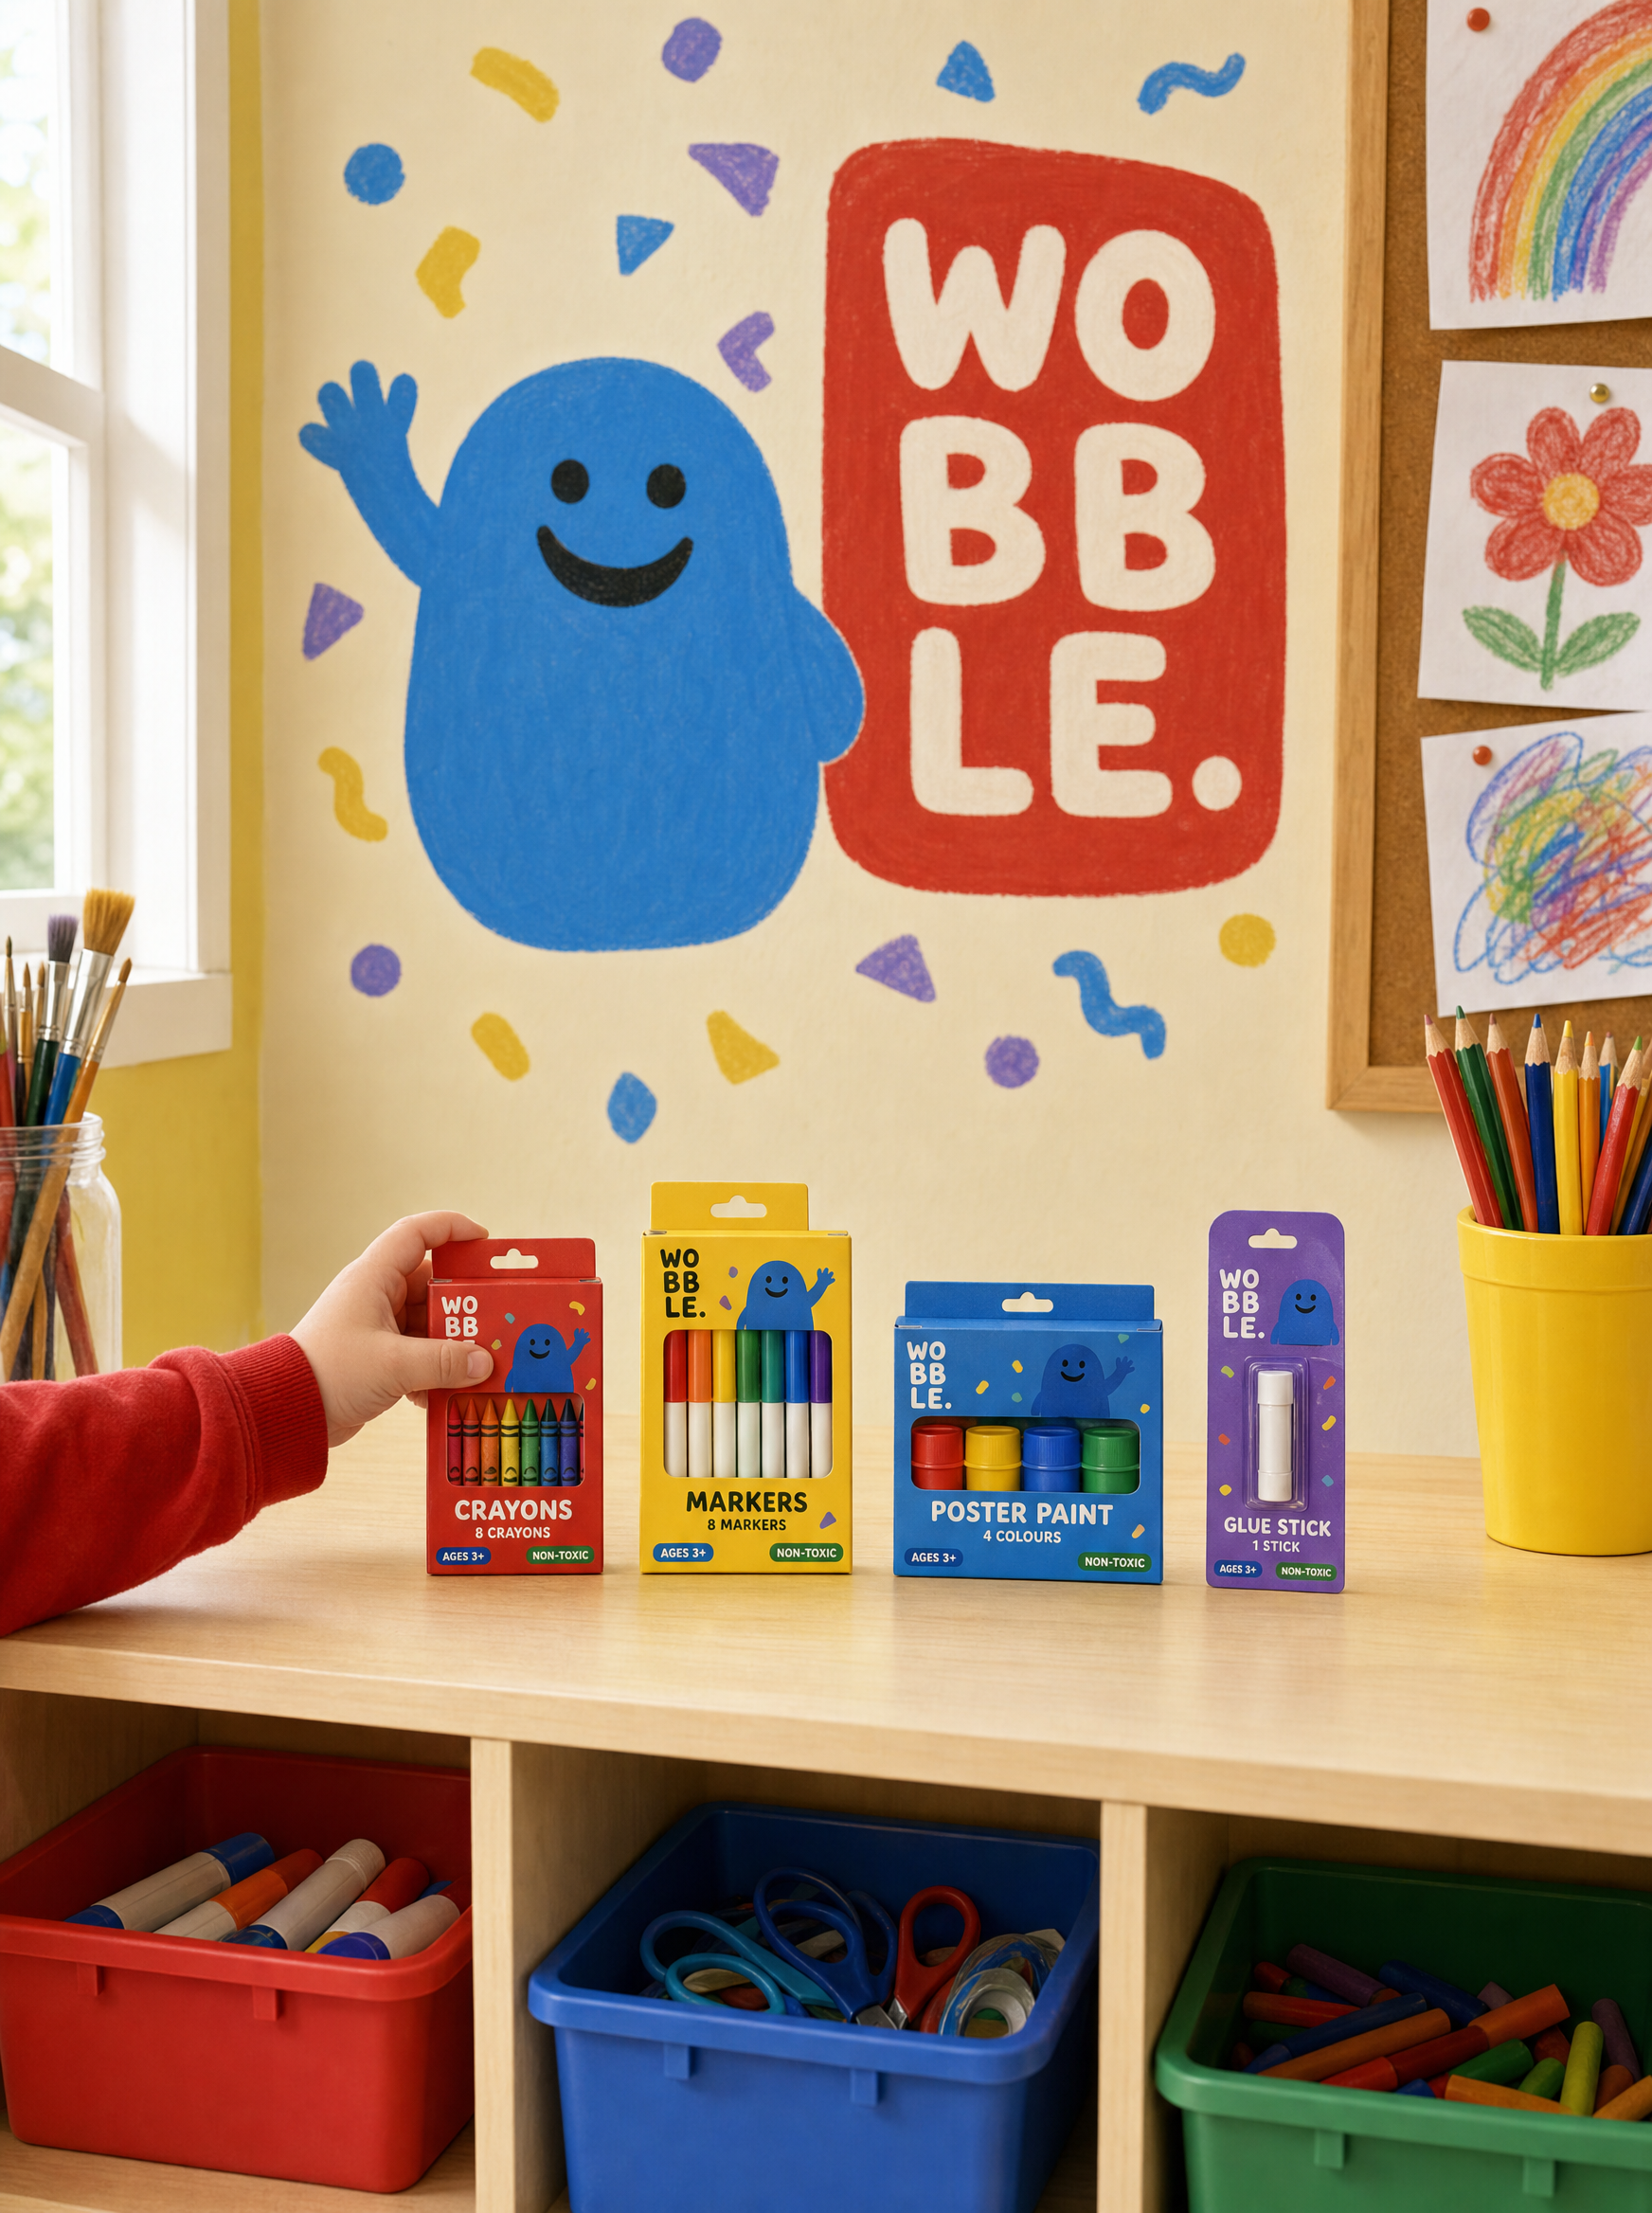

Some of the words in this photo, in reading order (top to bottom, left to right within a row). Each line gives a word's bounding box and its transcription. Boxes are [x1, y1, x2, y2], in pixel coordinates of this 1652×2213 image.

[883, 218, 1215, 402] WO
[900, 416, 1215, 612] BB
[910, 627, 1241, 818] LE.
[660, 1249, 699, 1268] WO
[663, 1271, 699, 1293] BB
[1219, 1268, 1259, 1289] WO
[441, 1296, 478, 1314] WO
[666, 1297, 706, 1318] LE.
[1223, 1291, 1259, 1314] BB
[445, 1317, 478, 1337] BB
[1224, 1316, 1265, 1339] LE.
[907, 1341, 946, 1360] WO
[910, 1363, 946, 1385] BB
[911, 1387, 951, 1410] LE.
[455, 1500, 572, 1520] CRAYONS
[686, 1491, 808, 1513] MARKERS
[931, 1501, 1027, 1523] POSTER
[1037, 1503, 1113, 1525] PAINT
[476, 1527, 483, 1538] 8
[488, 1527, 550, 1538] CRAYONS
[708, 1519, 715, 1530] 8
[721, 1519, 786, 1531] MARKERS
[1224, 1517, 1270, 1535] GLUE
[1278, 1520, 1331, 1538] STICK
[983, 1530, 992, 1541] 4
[997, 1531, 1061, 1543] COLOURS
[1252, 1540, 1259, 1551] 1
[1264, 1540, 1300, 1552] STICK
[442, 1552, 469, 1561] AGES
[472, 1552, 485, 1561] 3+
[532, 1551, 588, 1560] NON-TOXIC
[660, 1548, 689, 1558] AGES
[692, 1548, 706, 1558] 3+
[777, 1548, 836, 1558] NON-TOXIC
[911, 1553, 939, 1562] AGES
[943, 1553, 957, 1562] 3+
[1085, 1557, 1145, 1568] NON-TOXIC
[1219, 1564, 1243, 1574] AGES
[1246, 1565, 1257, 1574] 3+
[1282, 1567, 1332, 1577] NON-TOXIC
